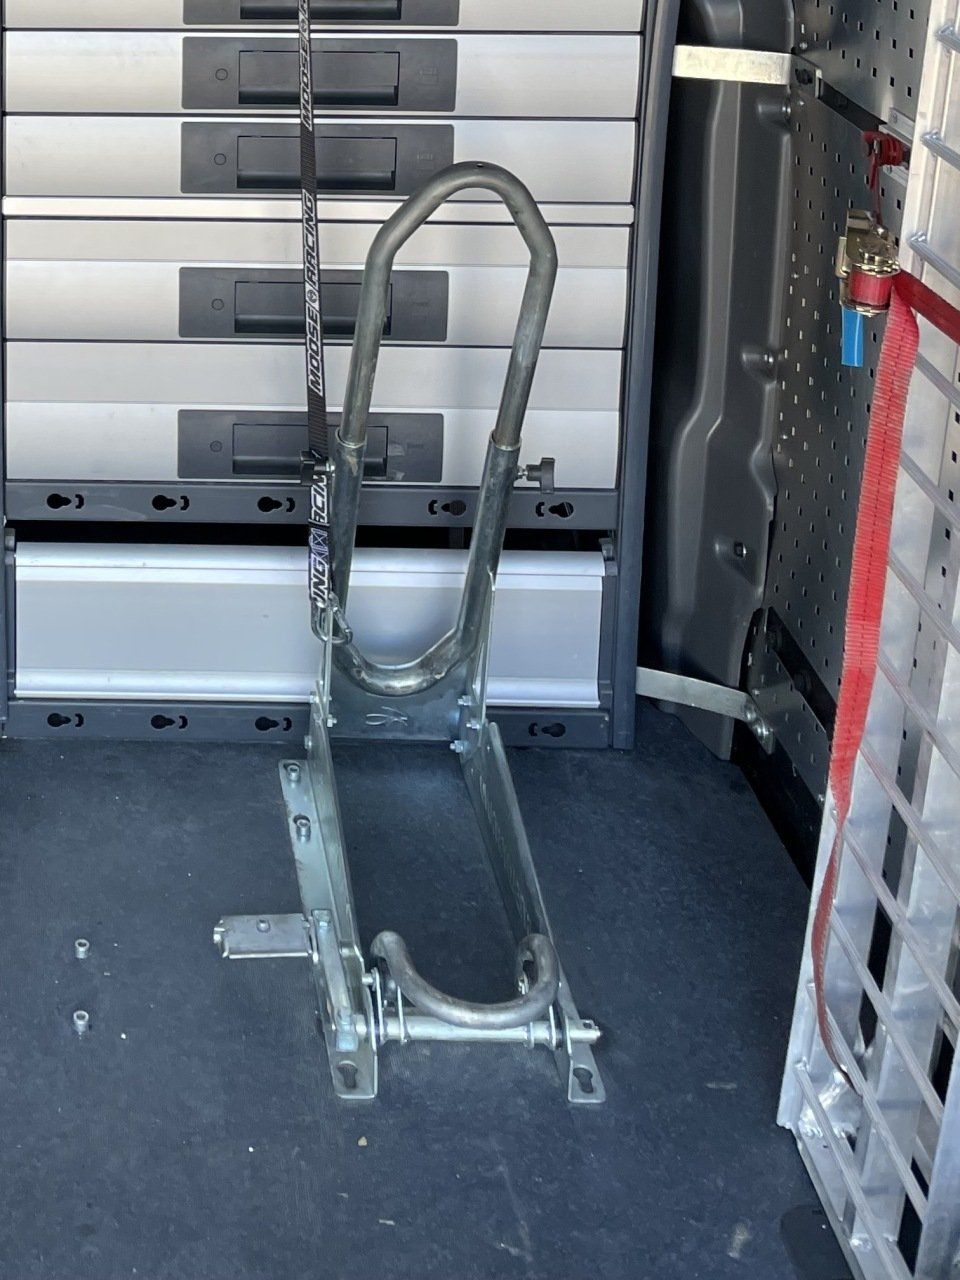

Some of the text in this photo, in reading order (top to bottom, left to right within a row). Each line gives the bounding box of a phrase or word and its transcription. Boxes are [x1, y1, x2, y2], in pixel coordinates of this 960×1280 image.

[299, 36, 312, 131] MOOSE
[301, 189, 324, 397] MOOSE RACING
